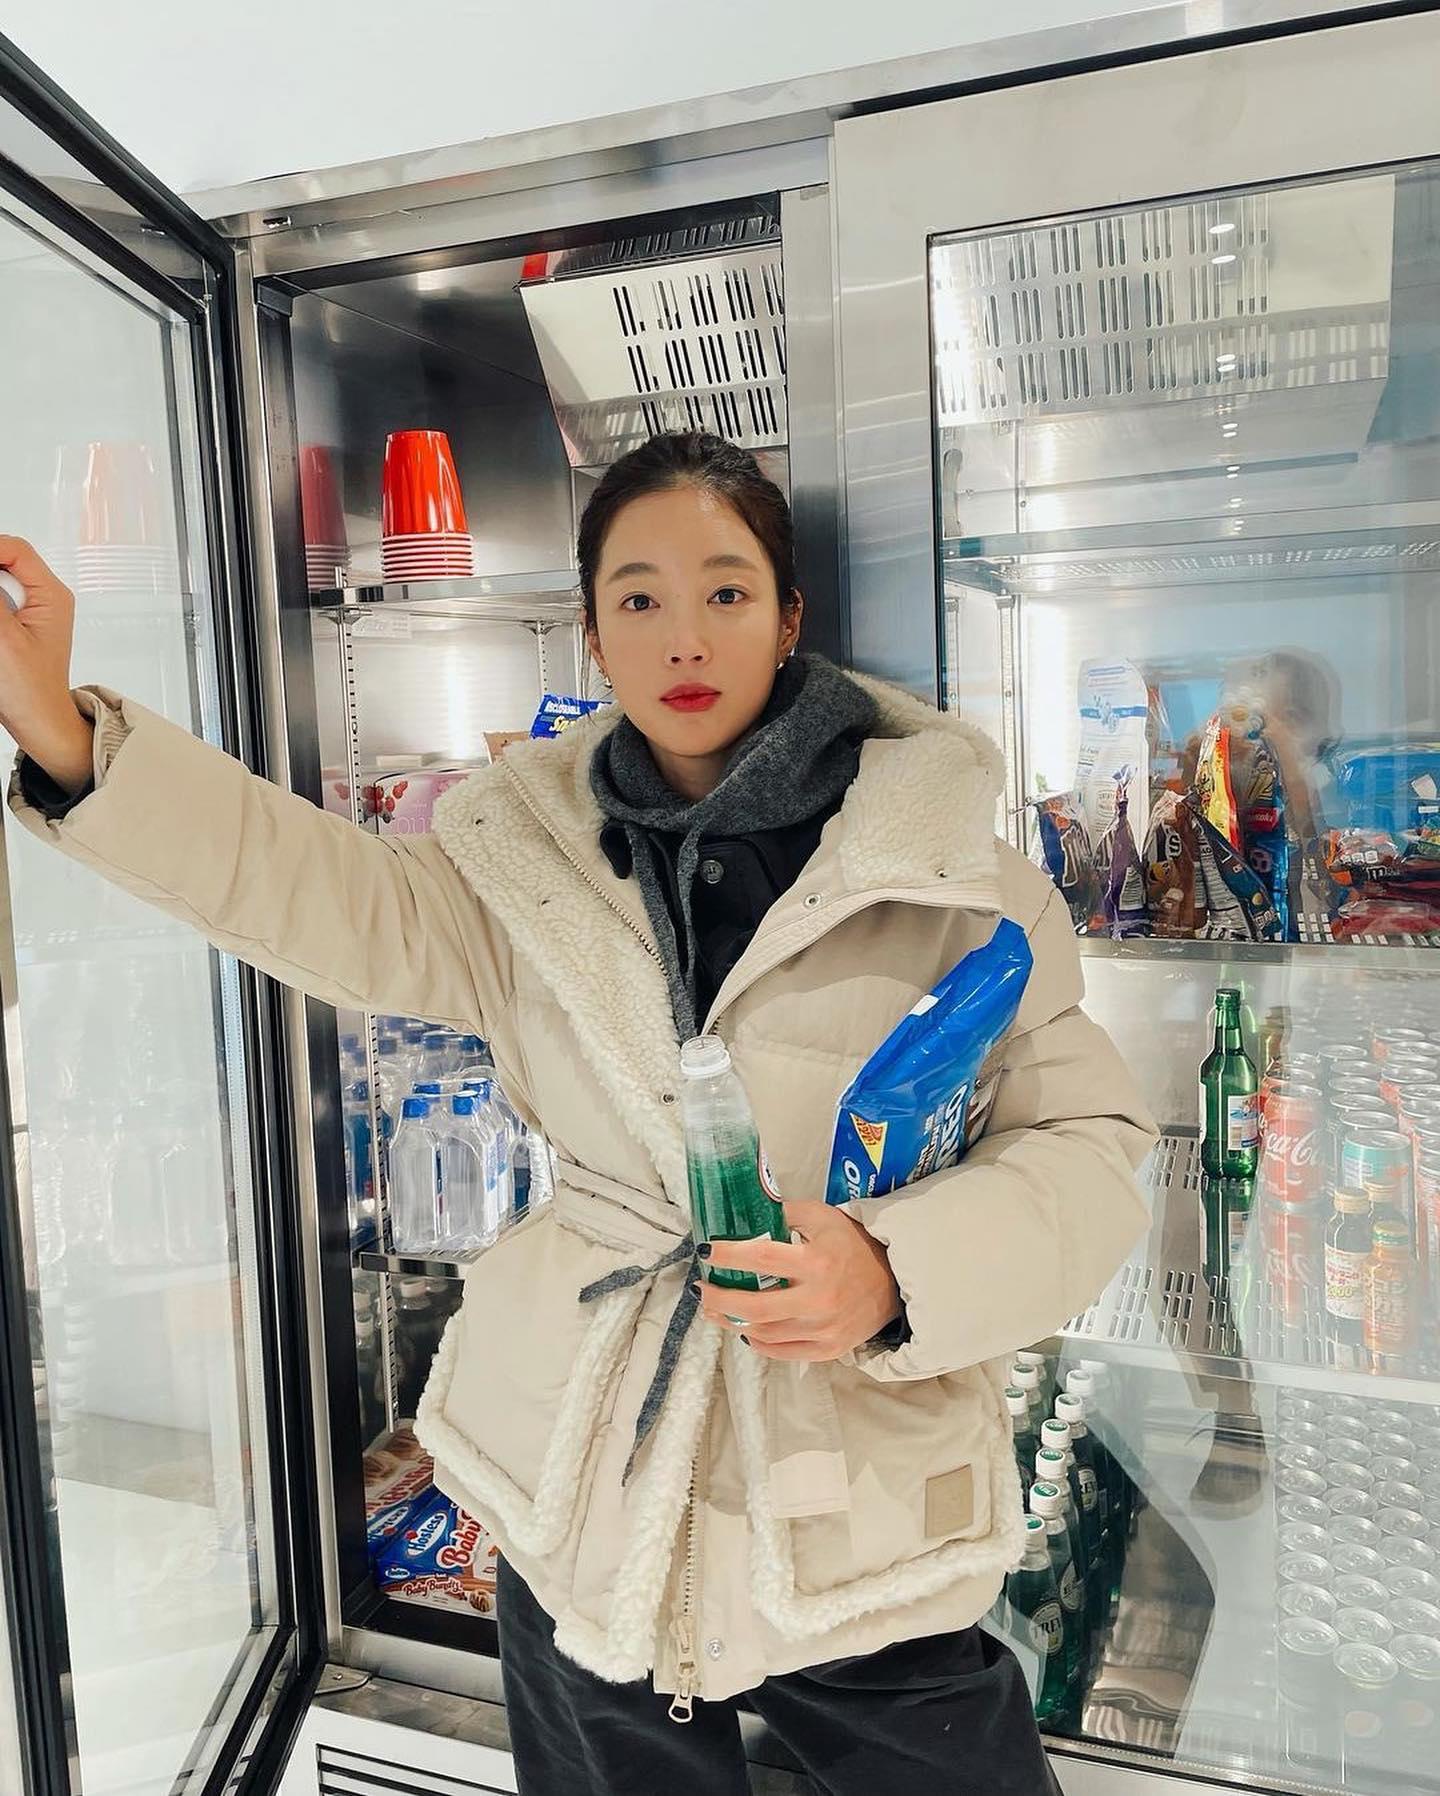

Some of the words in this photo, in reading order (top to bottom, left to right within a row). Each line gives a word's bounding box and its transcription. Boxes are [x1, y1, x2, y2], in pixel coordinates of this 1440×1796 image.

[843, 1158, 862, 1200] OR
[440, 1519, 484, 1566] Baby
[404, 1583, 430, 1597] Baby
